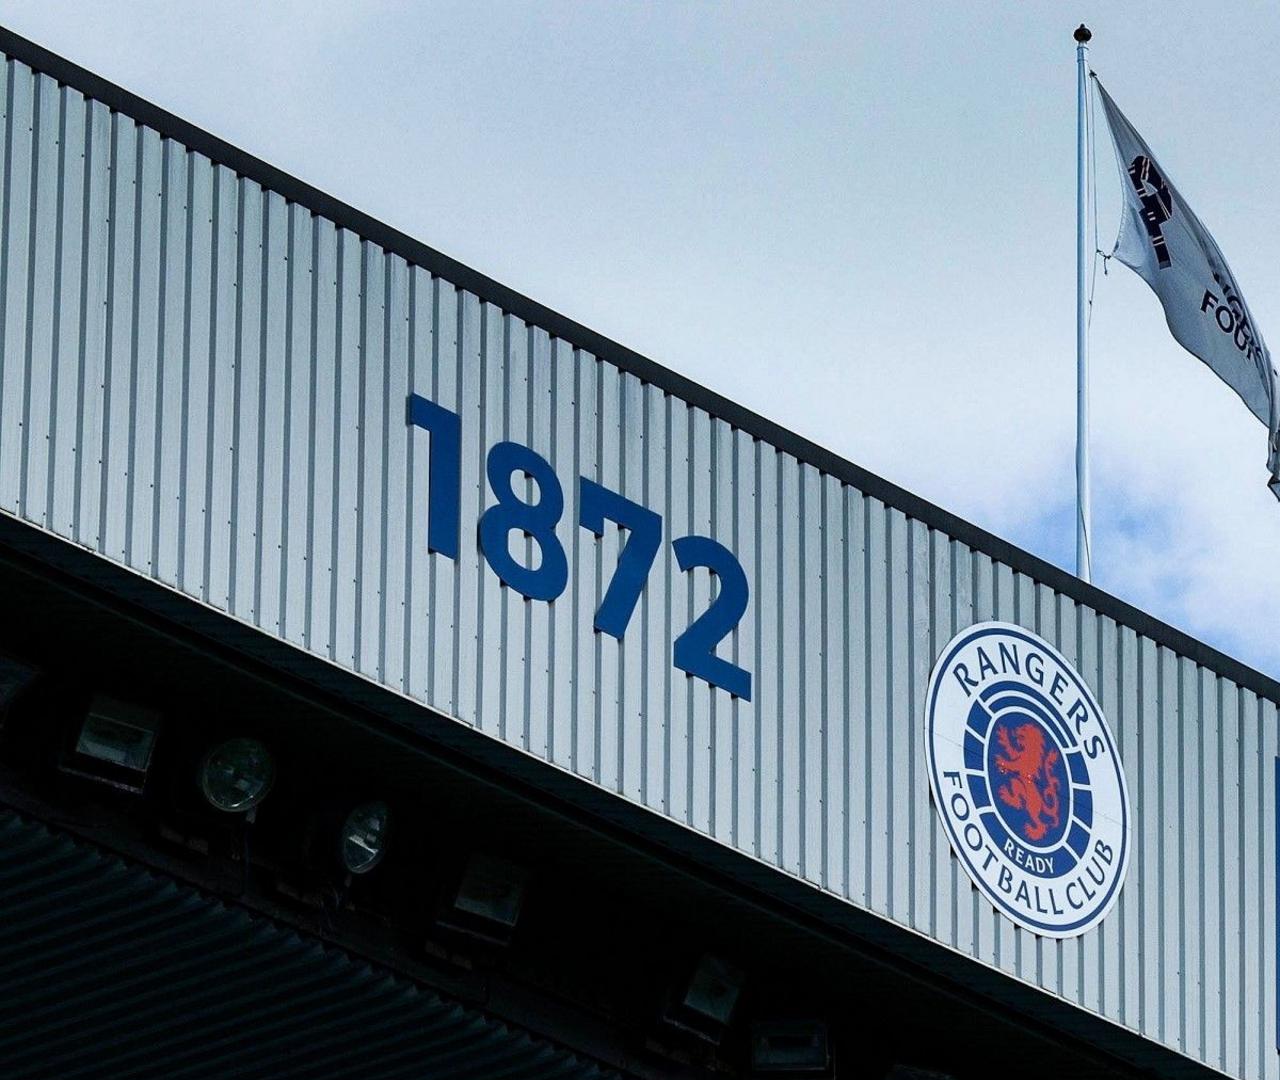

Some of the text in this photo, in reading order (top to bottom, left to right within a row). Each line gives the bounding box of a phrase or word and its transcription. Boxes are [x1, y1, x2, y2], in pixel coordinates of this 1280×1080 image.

[406, 392, 752, 703] 1872
[952, 641, 1105, 761] RANGERS
[943, 770, 1114, 916] FOOTBALL CLUB
[1004, 836, 1056, 875] READY
